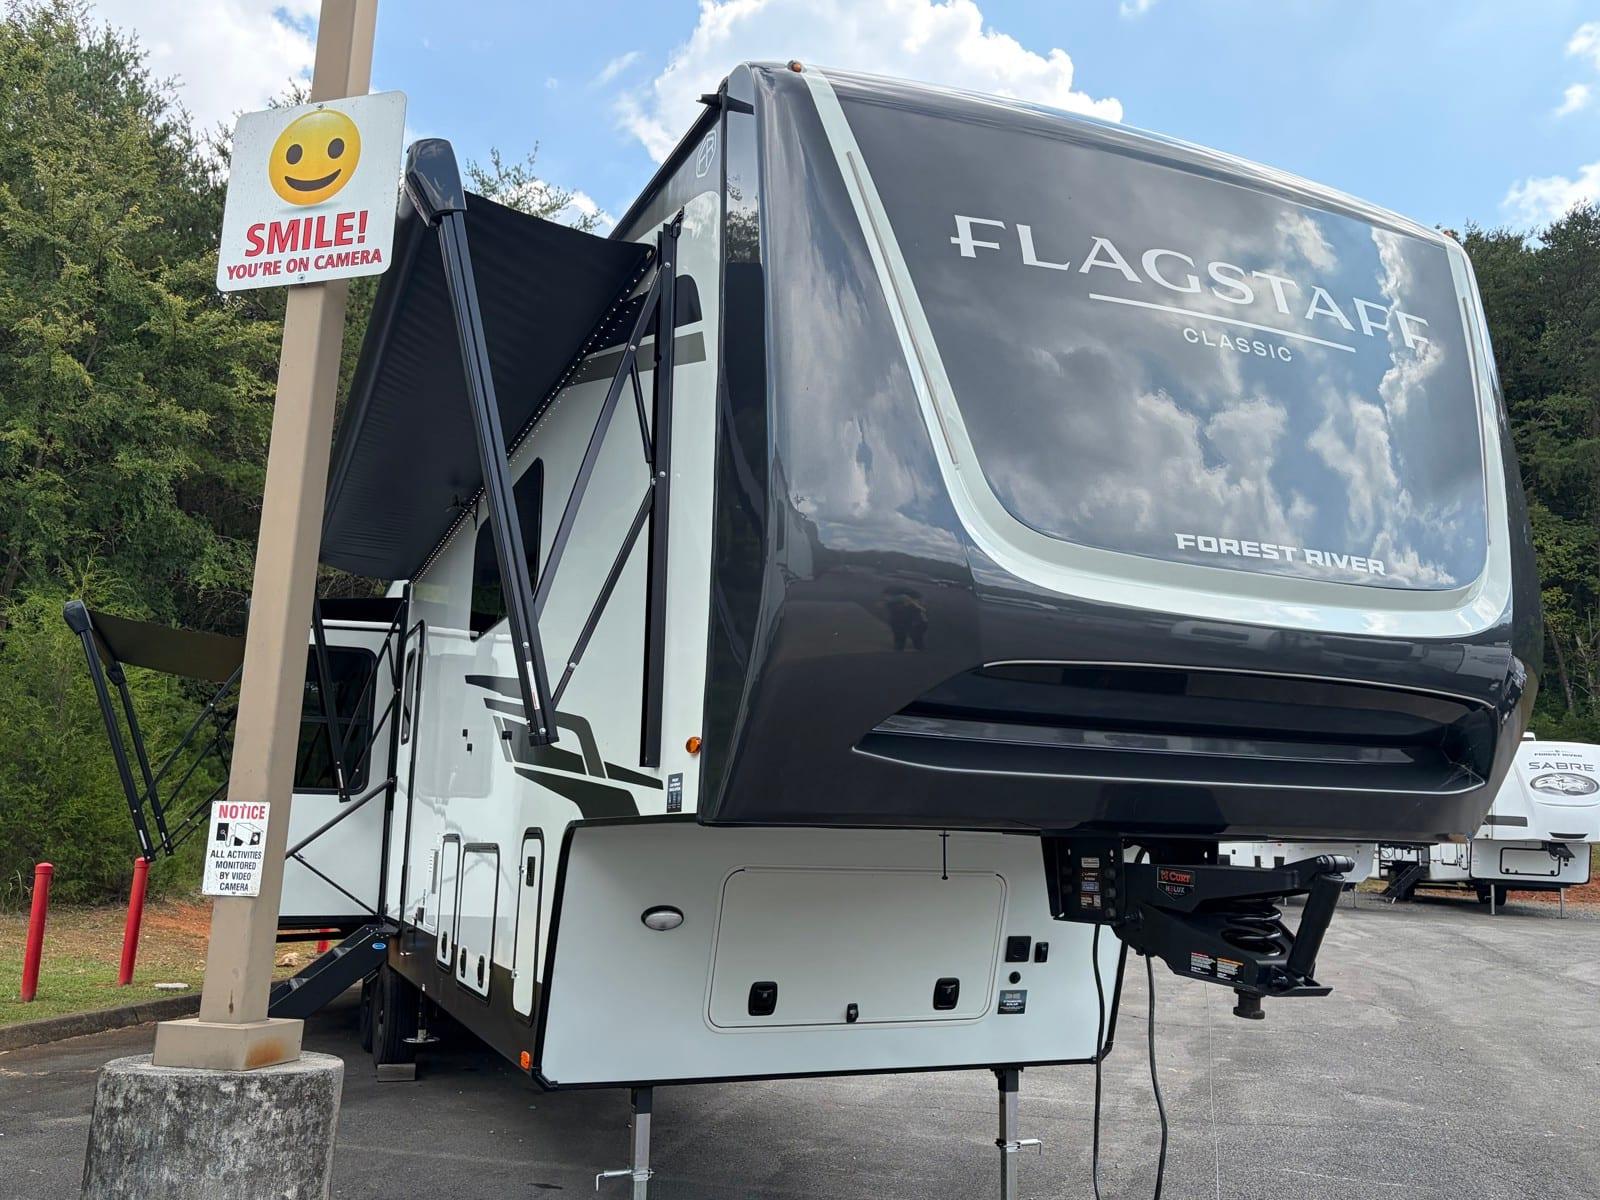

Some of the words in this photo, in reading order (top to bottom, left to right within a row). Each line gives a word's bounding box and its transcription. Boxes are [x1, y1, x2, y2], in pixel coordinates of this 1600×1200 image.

[245, 210, 369, 257] SMILE!
[226, 260, 282, 280] YOU'RE
[286, 257, 310, 273] ON
[314, 248, 382, 270] CAMERA
[950, 214, 1431, 350] FLAGSTAFF
[1182, 326, 1293, 363] CLASSIC
[1174, 532, 1298, 562] FOREST
[1302, 548, 1386, 576] RIVER
[1528, 761, 1596, 772] SABRE
[218, 805, 266, 820] NOTICE
[210, 850, 225, 858] ALL
[227, 850, 262, 860] ACTIVITIES
[215, 860, 257, 870] MONITORED
[219, 871, 230, 880] BY
[231, 872, 252, 881] VIDEO
[219, 882, 249, 892] CAMERA
